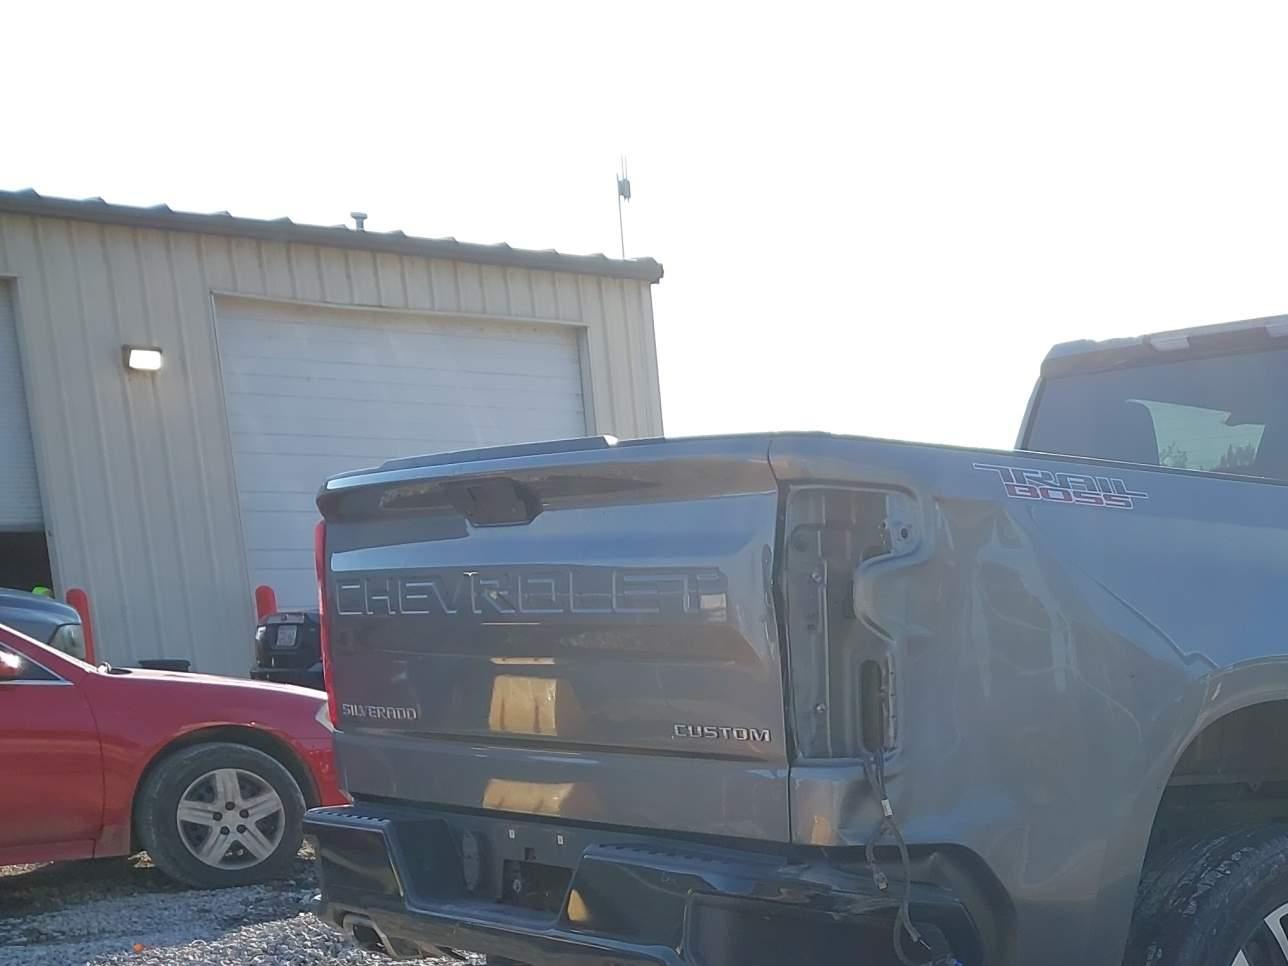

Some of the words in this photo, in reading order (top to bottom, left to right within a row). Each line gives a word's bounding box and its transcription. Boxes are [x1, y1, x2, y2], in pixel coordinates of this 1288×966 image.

[972, 463, 1149, 498] TRAIL
[1004, 483, 1133, 509] BOSS
[335, 568, 728, 616] CHEVROLET
[342, 703, 417, 720] SILVERADO
[673, 724, 772, 742] CUSTOM
